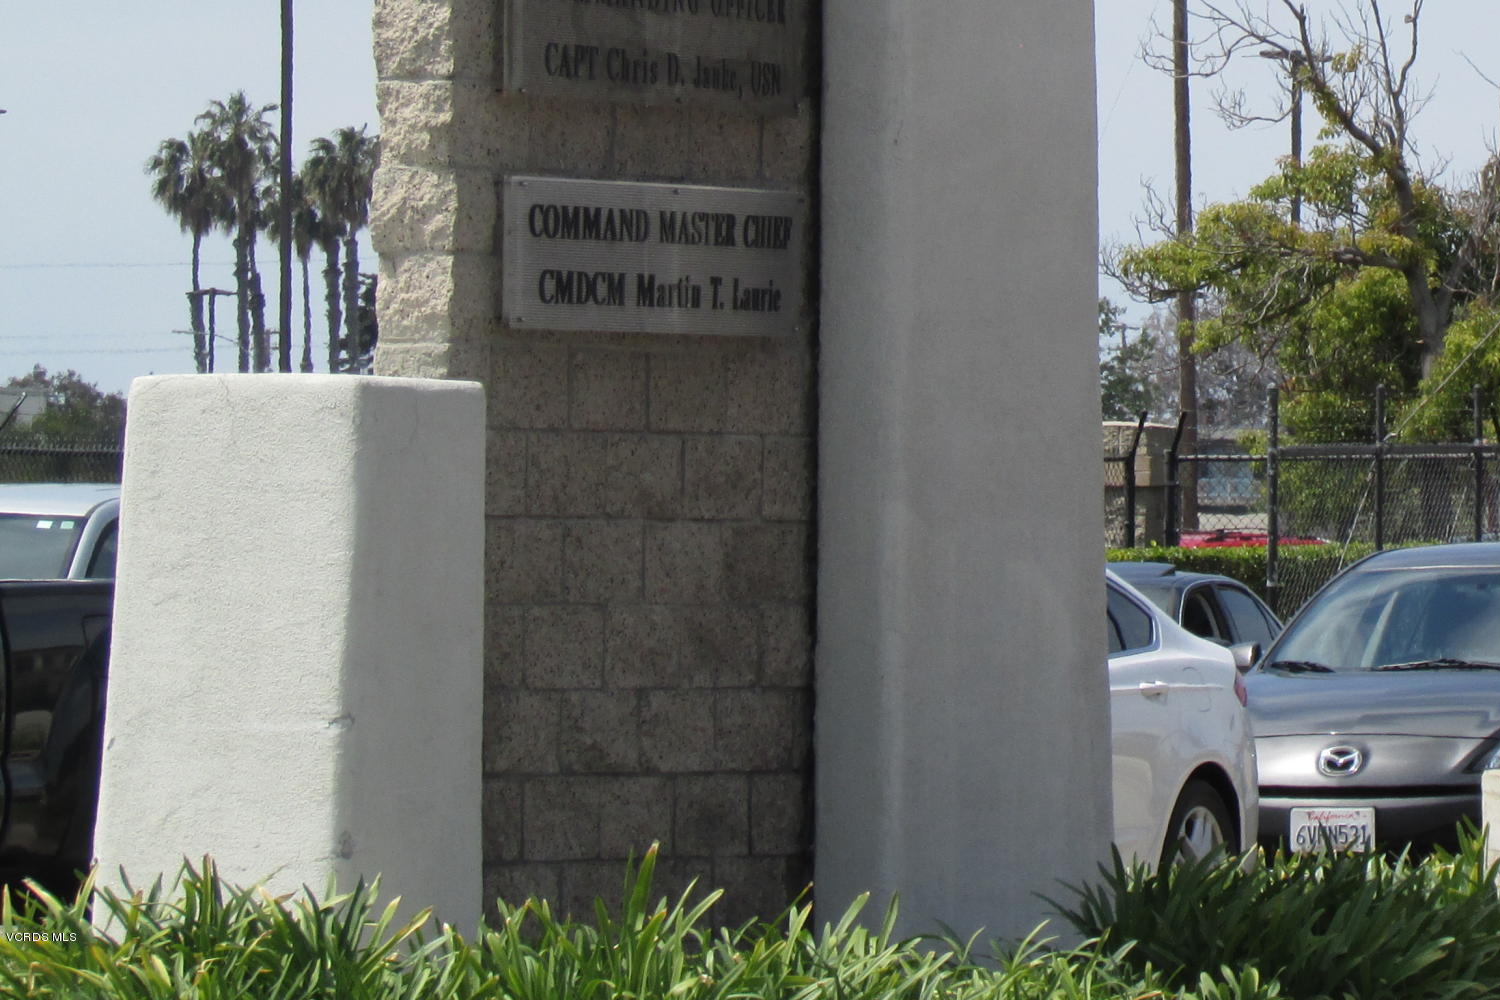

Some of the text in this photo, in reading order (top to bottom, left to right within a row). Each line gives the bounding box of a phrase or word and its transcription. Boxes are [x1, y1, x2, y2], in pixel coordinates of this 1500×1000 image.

[544, 42, 599, 81] CAPT
[606, 47, 658, 85] Chris
[528, 203, 793, 250] COMMAND MASTER CHIEF
[538, 268, 782, 312] CMDCM Martin T. Laurie
